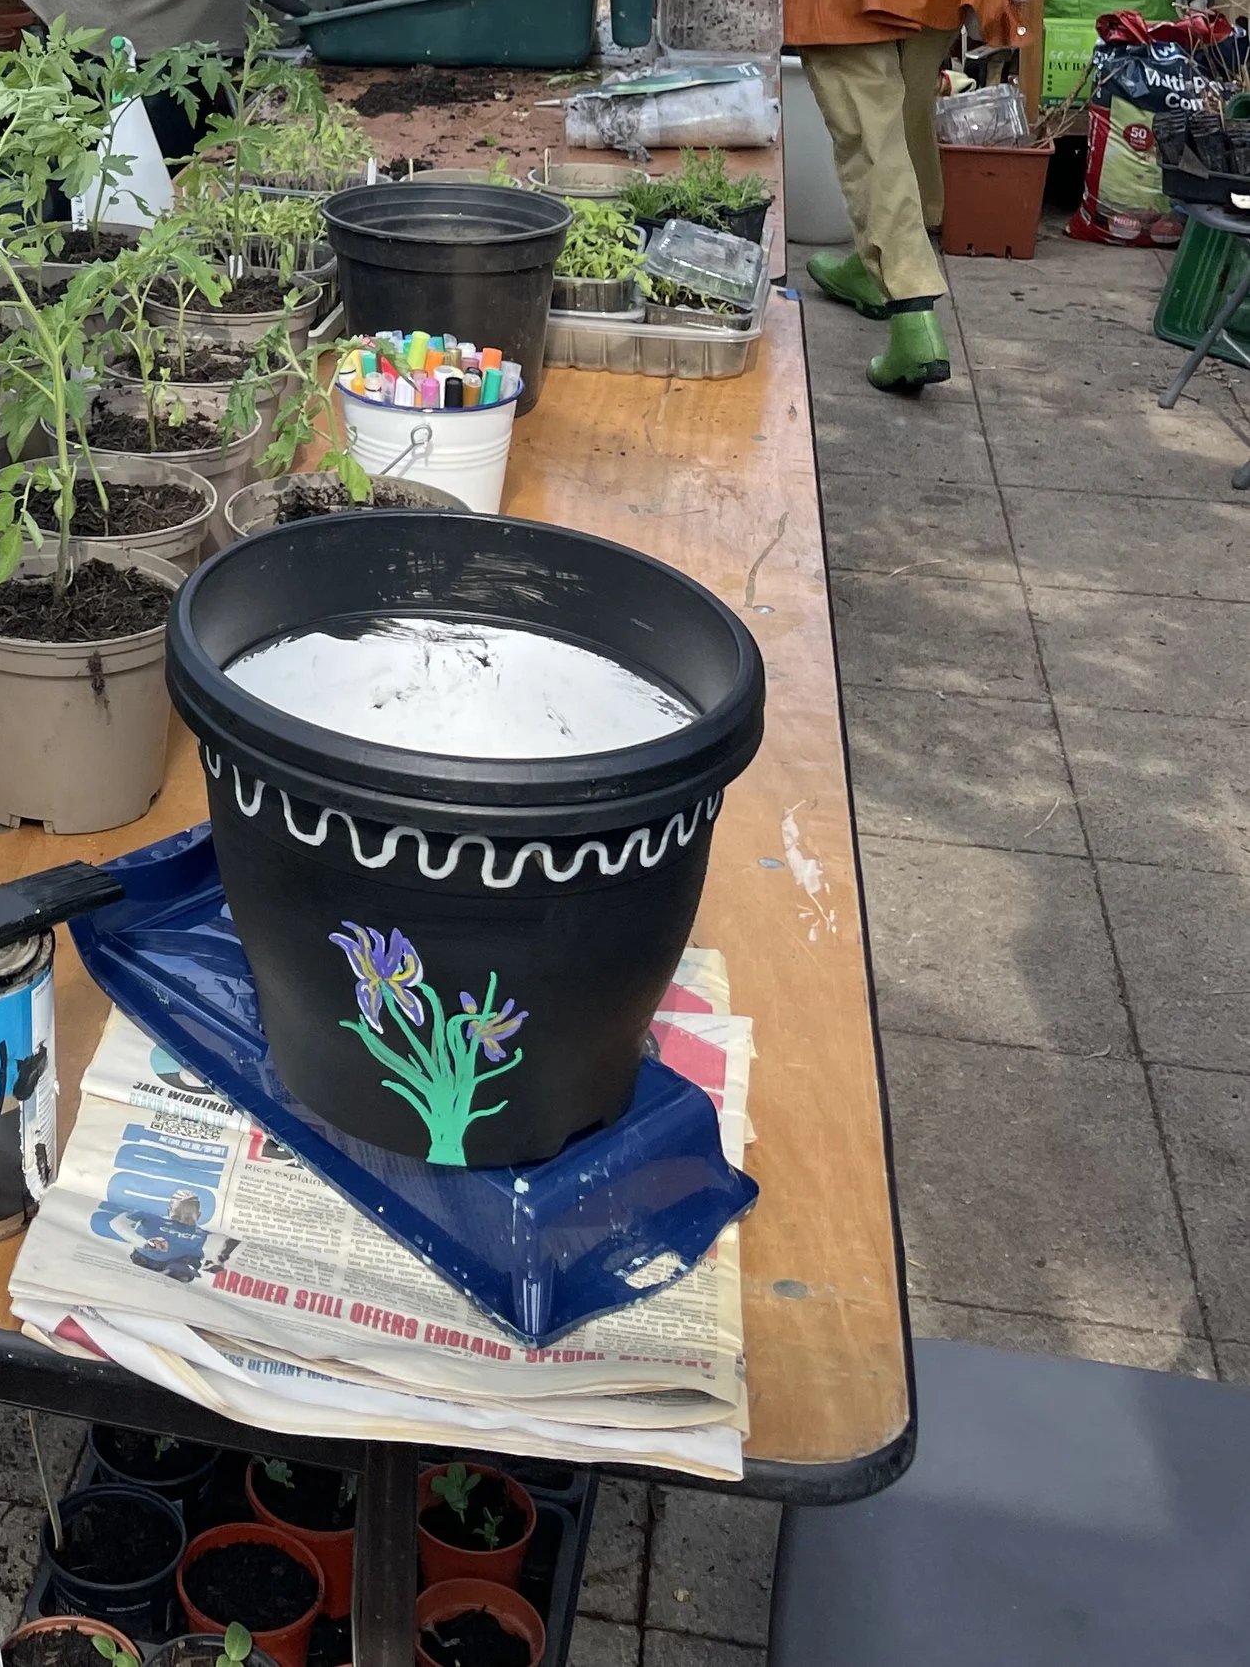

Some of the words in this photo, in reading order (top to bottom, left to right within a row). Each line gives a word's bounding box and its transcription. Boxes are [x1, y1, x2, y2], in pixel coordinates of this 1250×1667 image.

[1130, 126, 1147, 139] 50
[132, 1081, 165, 1096] JAKE
[167, 1090, 235, 1116] WIGHTMAN
[244, 1163, 271, 1176] Rice
[212, 1269, 288, 1306] ARCHER
[293, 1289, 343, 1319] STILL
[349, 1302, 419, 1340] OFFERS
[423, 1322, 511, 1362] ENGLAND
[248, 1358, 302, 1378] BETHANY
